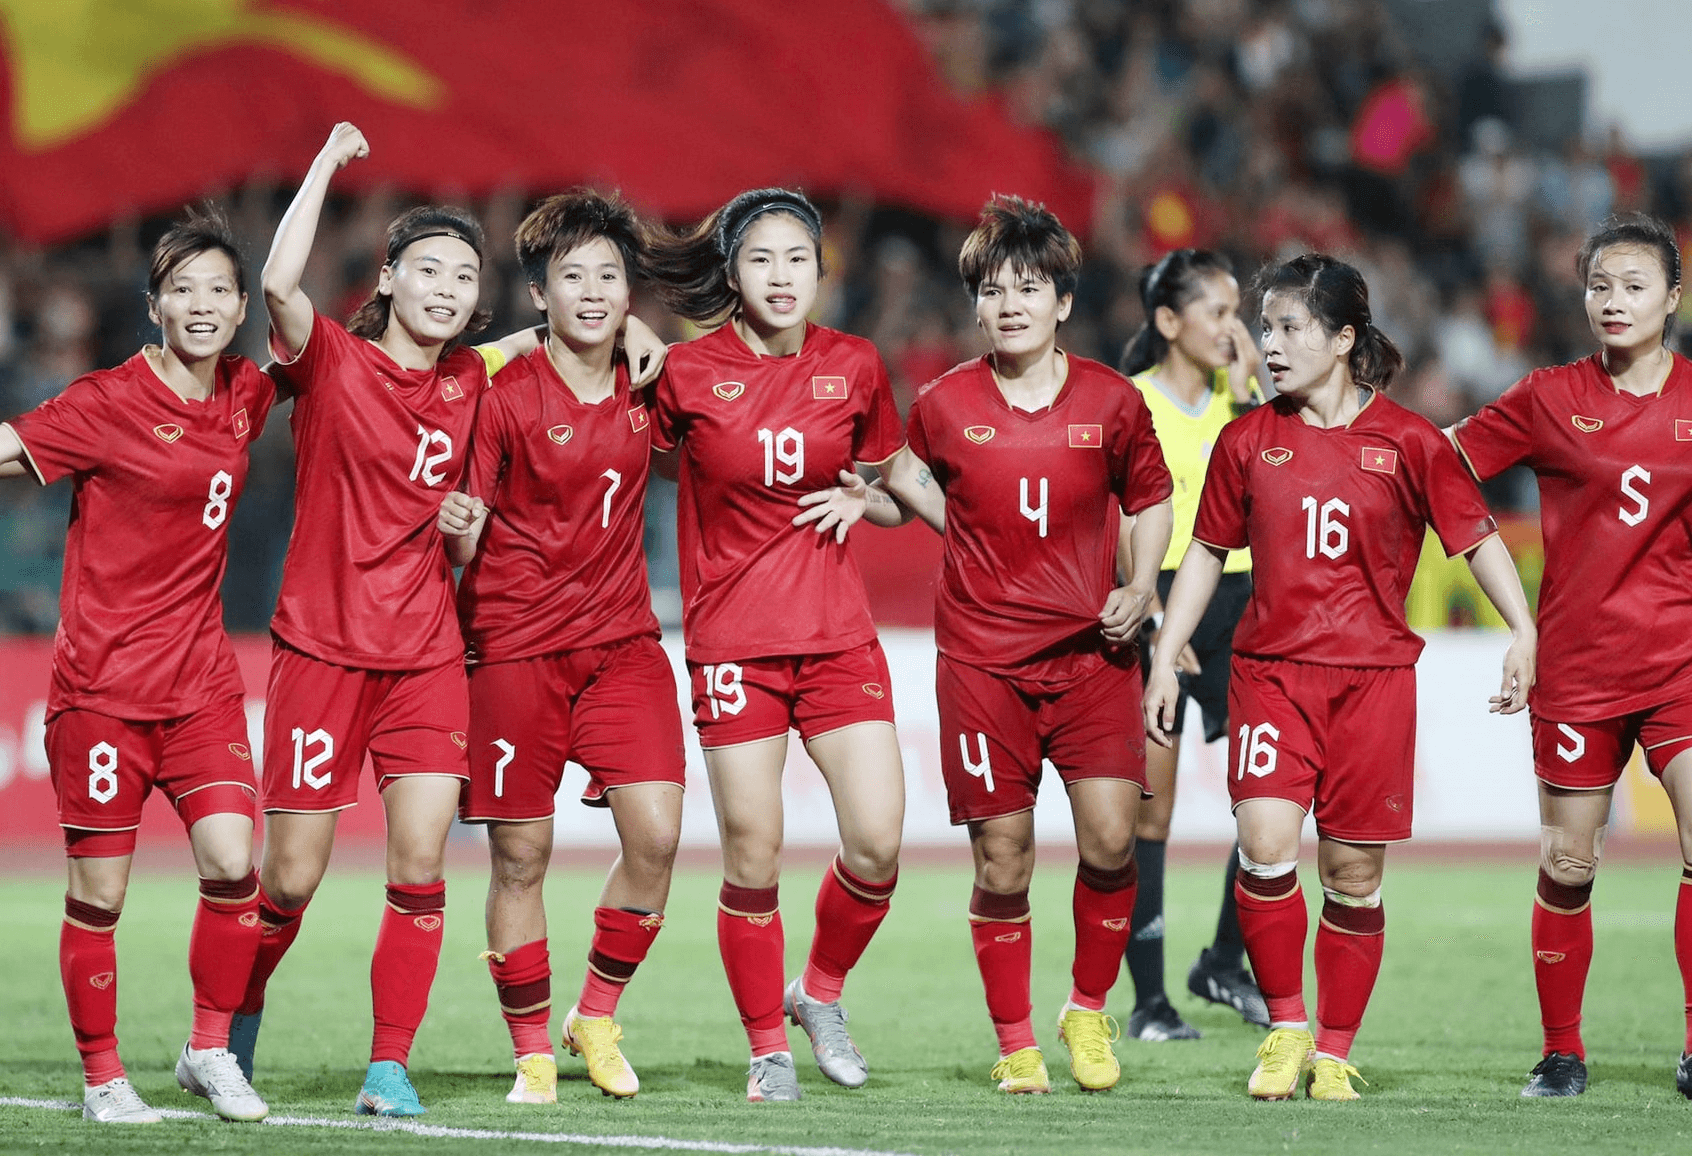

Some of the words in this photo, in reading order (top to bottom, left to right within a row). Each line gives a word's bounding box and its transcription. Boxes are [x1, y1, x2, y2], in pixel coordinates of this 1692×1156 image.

[408, 423, 454, 487] 12
[756, 425, 805, 487] 19
[202, 469, 233, 531] 8
[599, 467, 622, 529] 7
[1019, 476, 1049, 538] 4
[1301, 495, 1350, 560] 16
[703, 662, 748, 720] 19
[88, 740, 119, 805] 8
[291, 726, 334, 791] 12
[491, 738, 516, 798] 7
[959, 731, 996, 793] 4
[1237, 721, 1281, 781] 16
